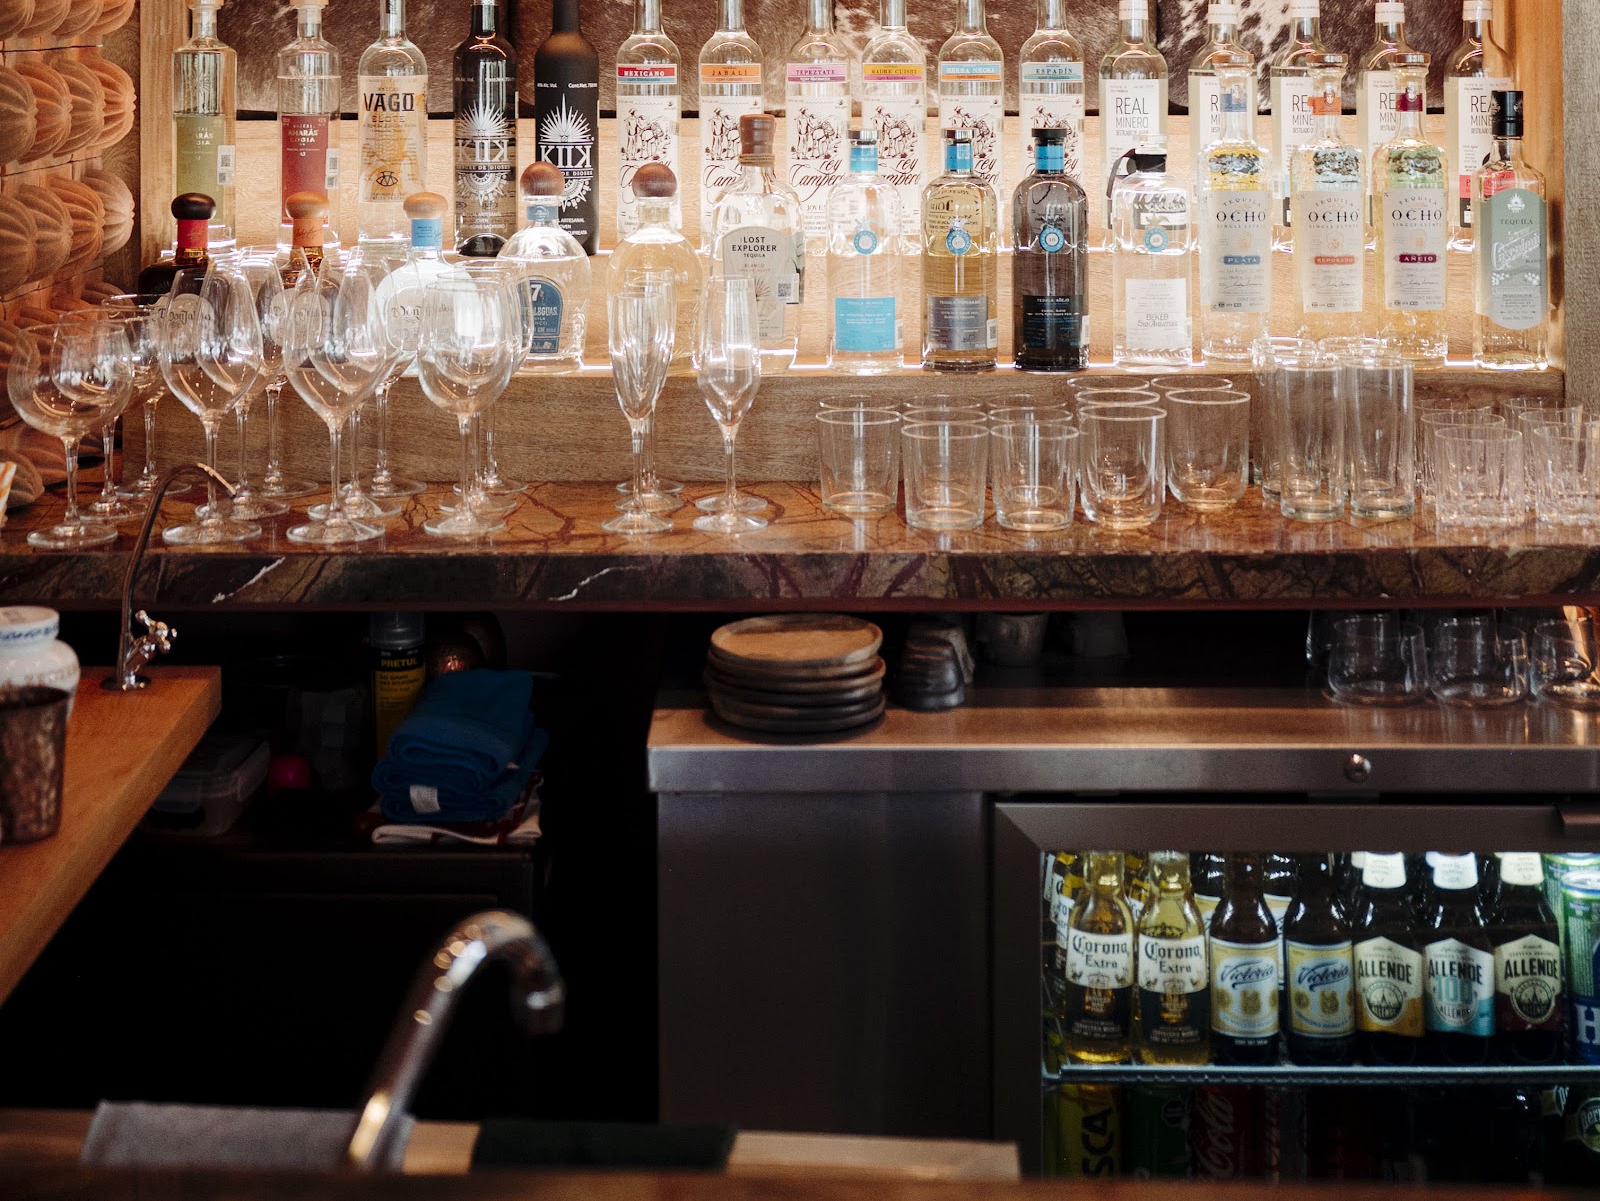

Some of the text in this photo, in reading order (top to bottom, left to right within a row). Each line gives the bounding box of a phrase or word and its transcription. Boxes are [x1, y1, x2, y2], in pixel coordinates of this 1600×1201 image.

[363, 92, 415, 112] VAGO
[1115, 97, 1149, 115] REAL
[1292, 94, 1309, 112] RE
[1379, 92, 1396, 110] RE
[1115, 117, 1149, 129] MINERO
[1292, 115, 1314, 126] MINE
[1379, 112, 1397, 123] MIN
[288, 128, 319, 137] AMARÁS
[489, 163, 511, 171] DIOSES
[815, 158, 843, 173] rey
[892, 158, 919, 173] rey
[974, 158, 997, 173] rey
[1063, 158, 1079, 172] ey
[789, 164, 845, 195] Camper
[1223, 197, 1261, 207] TEQUILA
[1315, 197, 1354, 207] TEQUILA
[1216, 211, 1266, 222] OCHO
[1308, 211, 1359, 222] OCHO
[1391, 209, 1442, 221] OCHO
[530, 283, 542, 302] 7
[381, 657, 417, 668] PRETUL
[1072, 933, 1130, 956] Corona
[1144, 940, 1202, 964] Corona
[1084, 954, 1118, 970] Extra
[1159, 961, 1192, 974] Extra
[1504, 958, 1558, 980] ALLENDE
[1220, 960, 1275, 989] Victoria
[1297, 960, 1350, 992] Victoria
[1357, 959, 1412, 985] ALLENDE
[1428, 959, 1483, 986] ALLENDE
[1437, 975, 1473, 1005] 100
